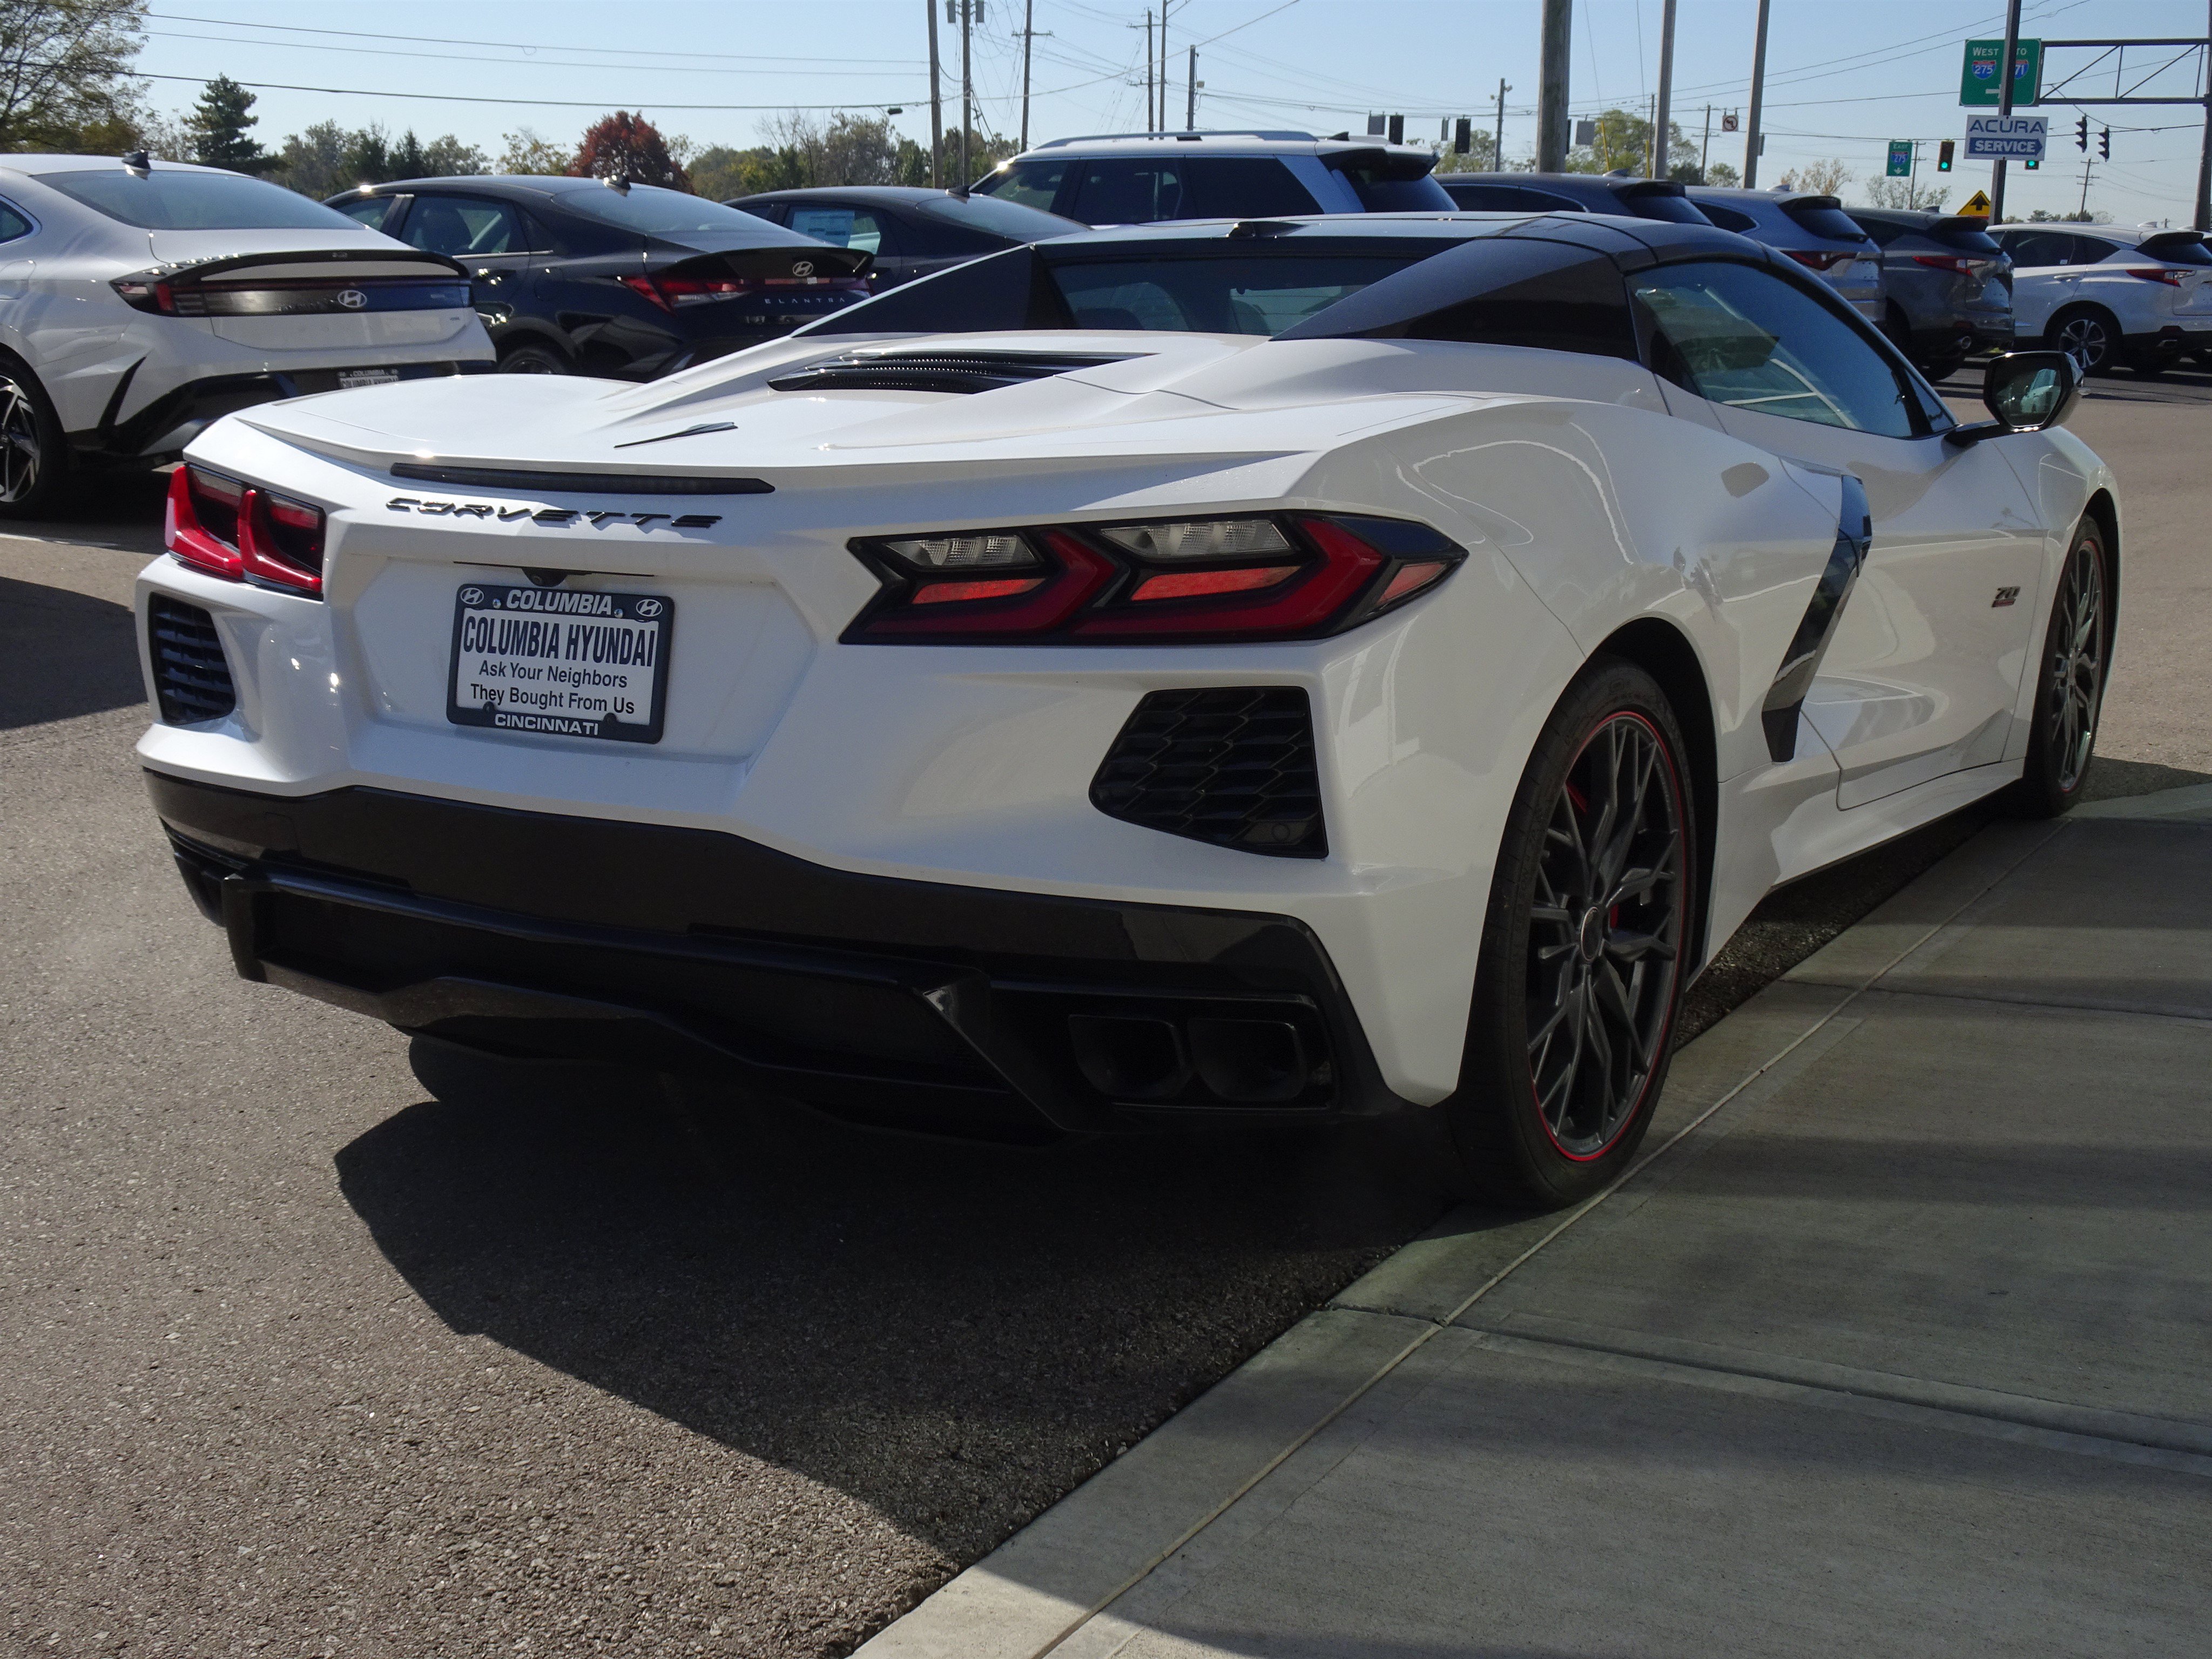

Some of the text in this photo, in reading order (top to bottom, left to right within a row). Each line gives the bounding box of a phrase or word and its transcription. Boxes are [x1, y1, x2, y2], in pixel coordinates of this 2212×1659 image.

[1973, 47, 1999, 56] WEST
[1974, 64, 2025, 75] 275 71
[1968, 119, 2045, 133] ACURA
[1975, 140, 2036, 153] SERVICE
[1894, 154, 1906, 163] 275
[386, 497, 722, 529] CORVETTE
[507, 590, 612, 615] COLUMBIA
[463, 616, 655, 667] COLUMBIA HYUNDAI
[479, 660, 628, 688] Ask Your Neighbors
[471, 683, 635, 714] They Bought From Us
[495, 714, 599, 736] CINCINNATI
